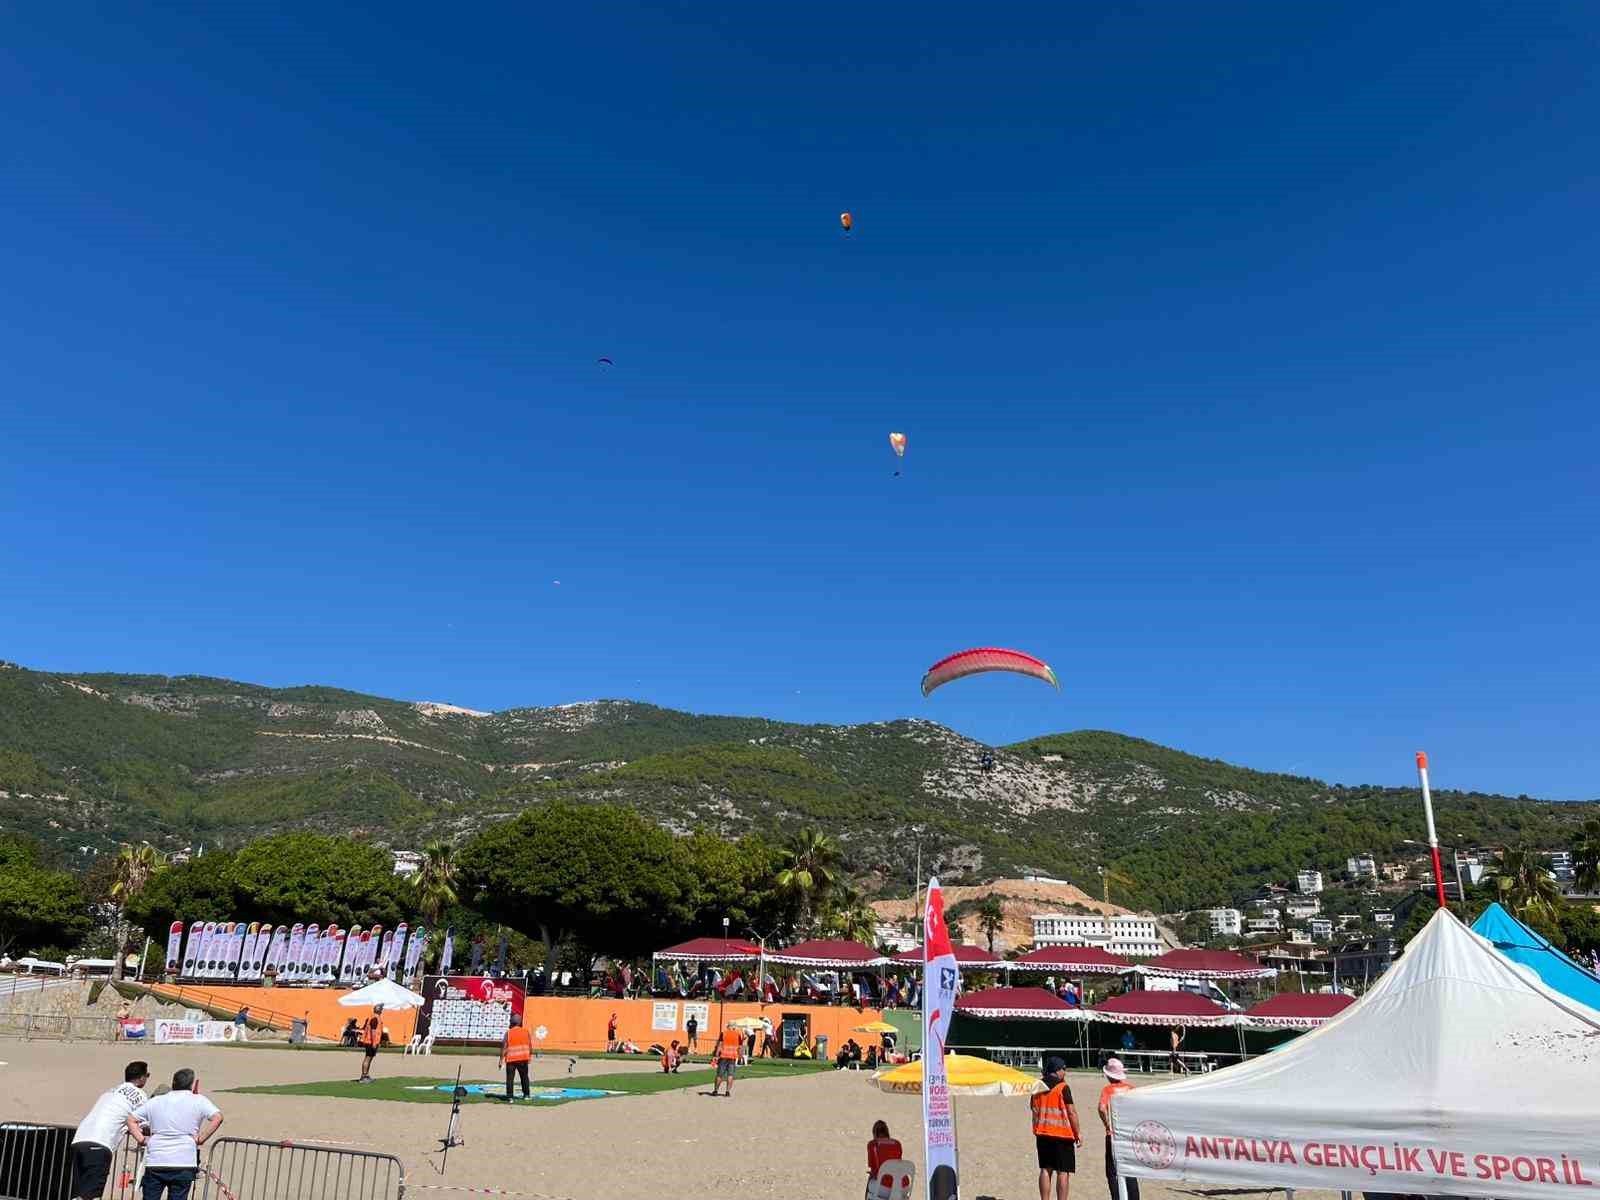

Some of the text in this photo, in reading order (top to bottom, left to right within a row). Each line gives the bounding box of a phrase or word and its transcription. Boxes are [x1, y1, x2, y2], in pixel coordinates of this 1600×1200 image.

[1184, 1135, 1593, 1186] ANTALYA GENÇLİK VE SPOR İL
